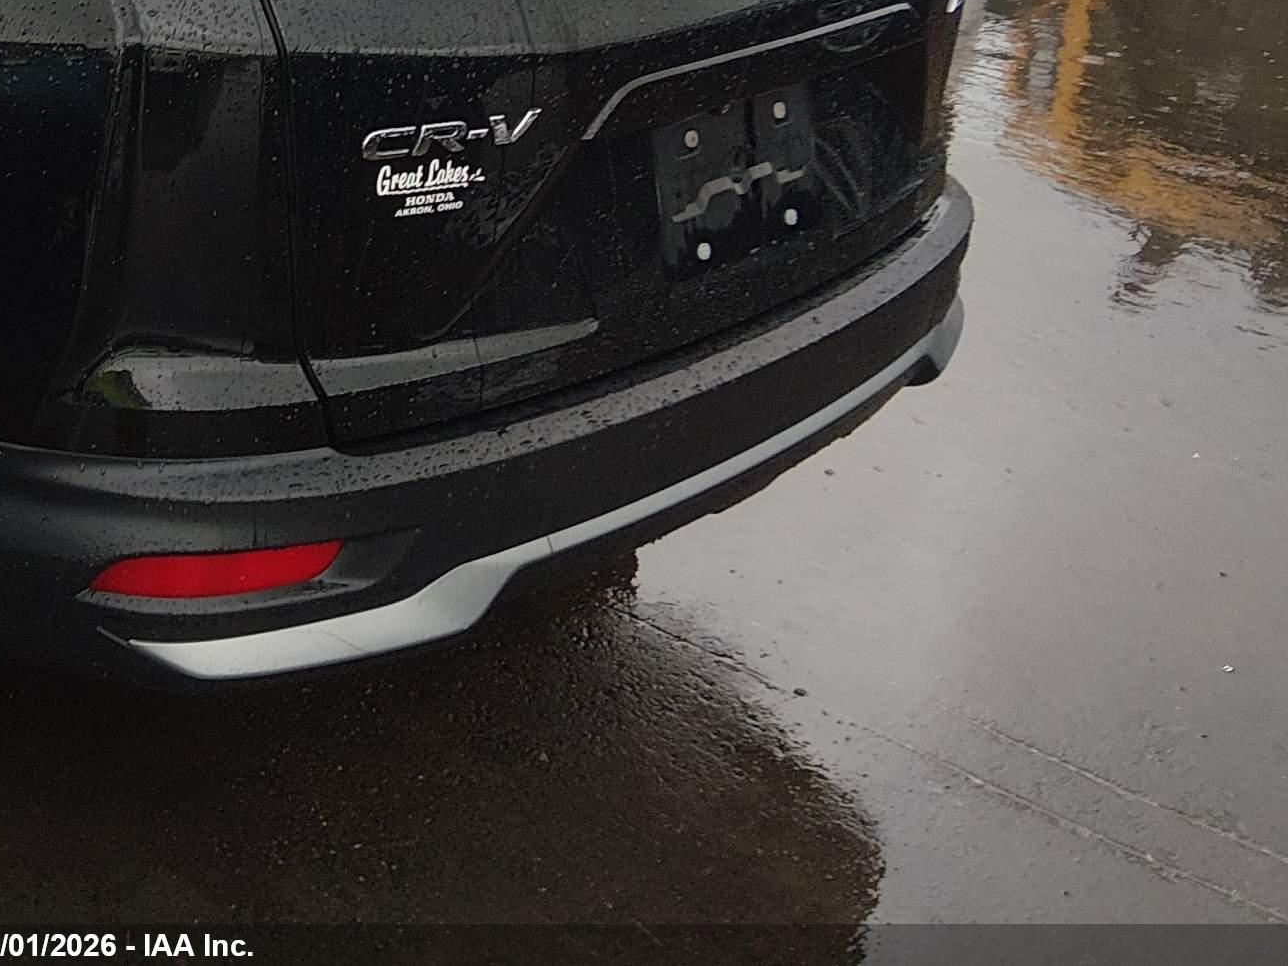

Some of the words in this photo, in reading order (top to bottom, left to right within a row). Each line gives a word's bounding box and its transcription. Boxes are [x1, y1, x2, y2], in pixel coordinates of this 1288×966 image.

[362, 107, 543, 161] CR-V
[376, 164, 424, 196] Great
[424, 158, 470, 187] Lakes
[394, 207, 436, 218] AKRON,
[437, 200, 464, 212] OHIO
[405, 192, 455, 207] HONDA
